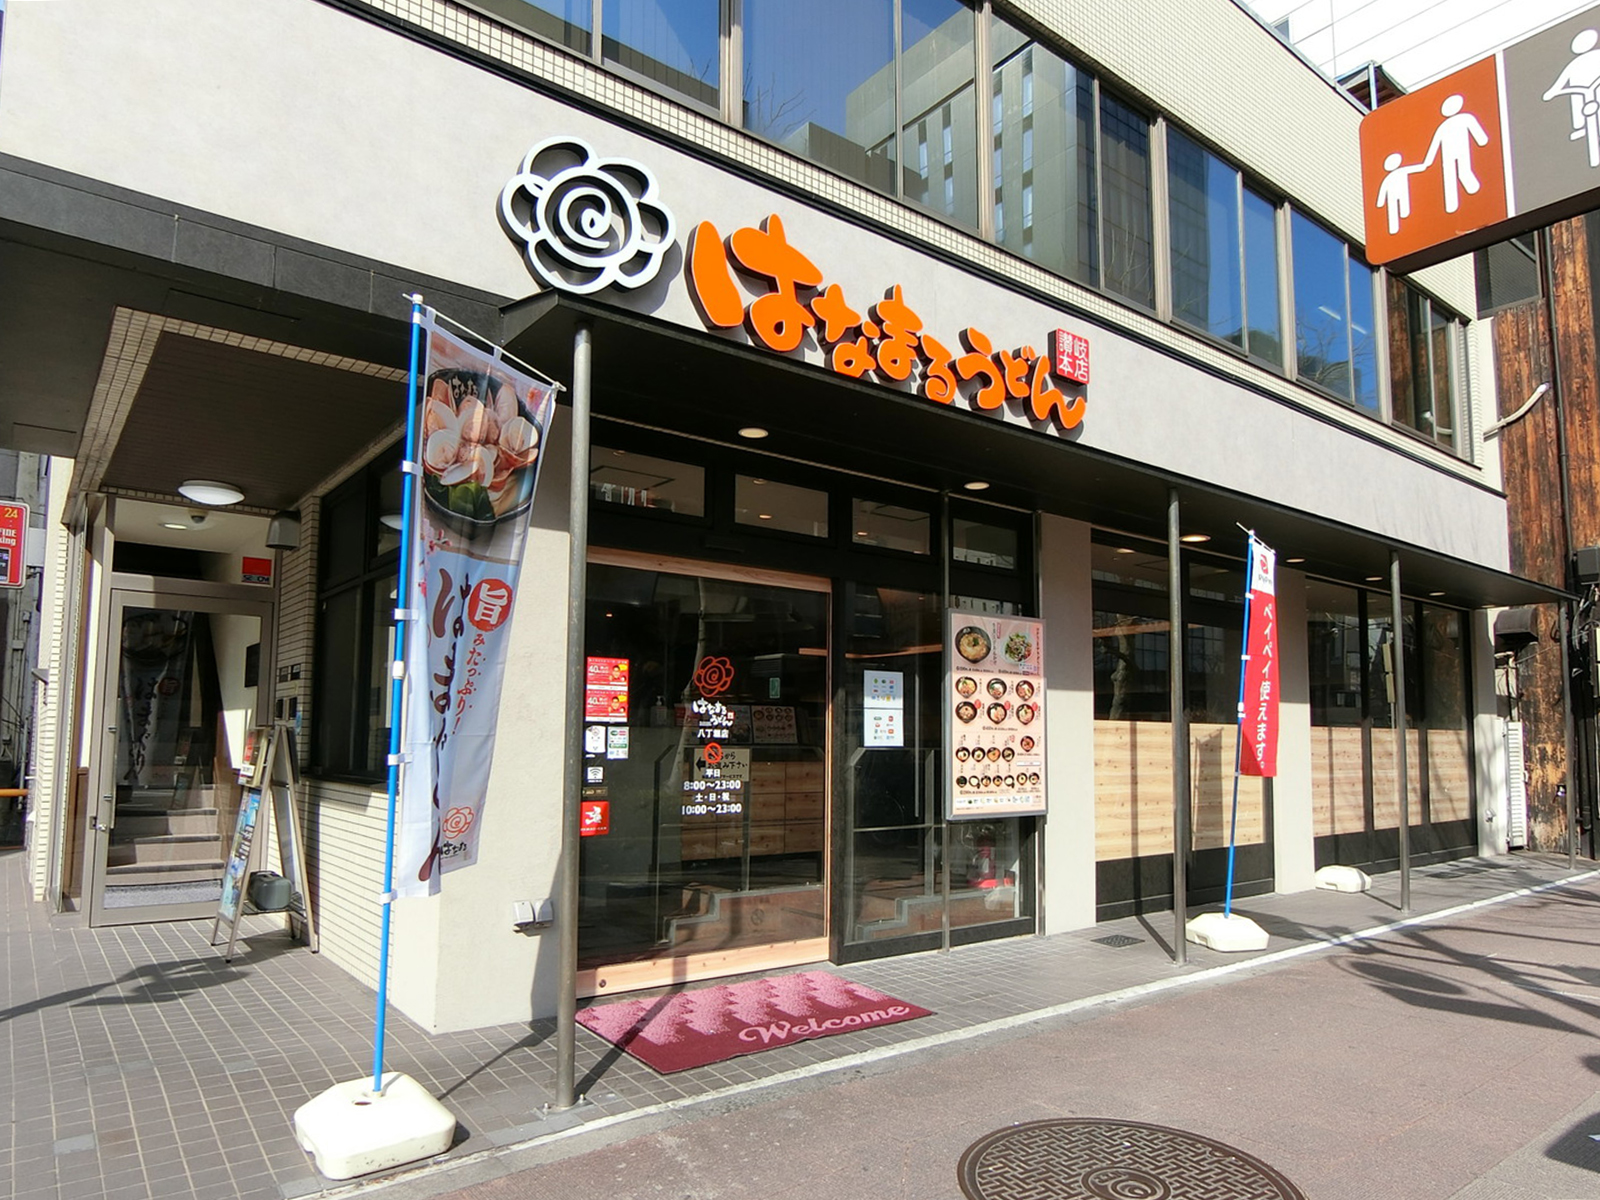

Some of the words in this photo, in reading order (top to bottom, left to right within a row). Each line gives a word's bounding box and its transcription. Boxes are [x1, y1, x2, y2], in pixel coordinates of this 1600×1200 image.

[690, 213, 1086, 429] はなまるうどん
[4, 507, 18, 518] 24
[1256, 604, 1274, 769] ペイペイ使えます。
[705, 768, 720, 778] 平日
[738, 1004, 911, 1044] Welcome
